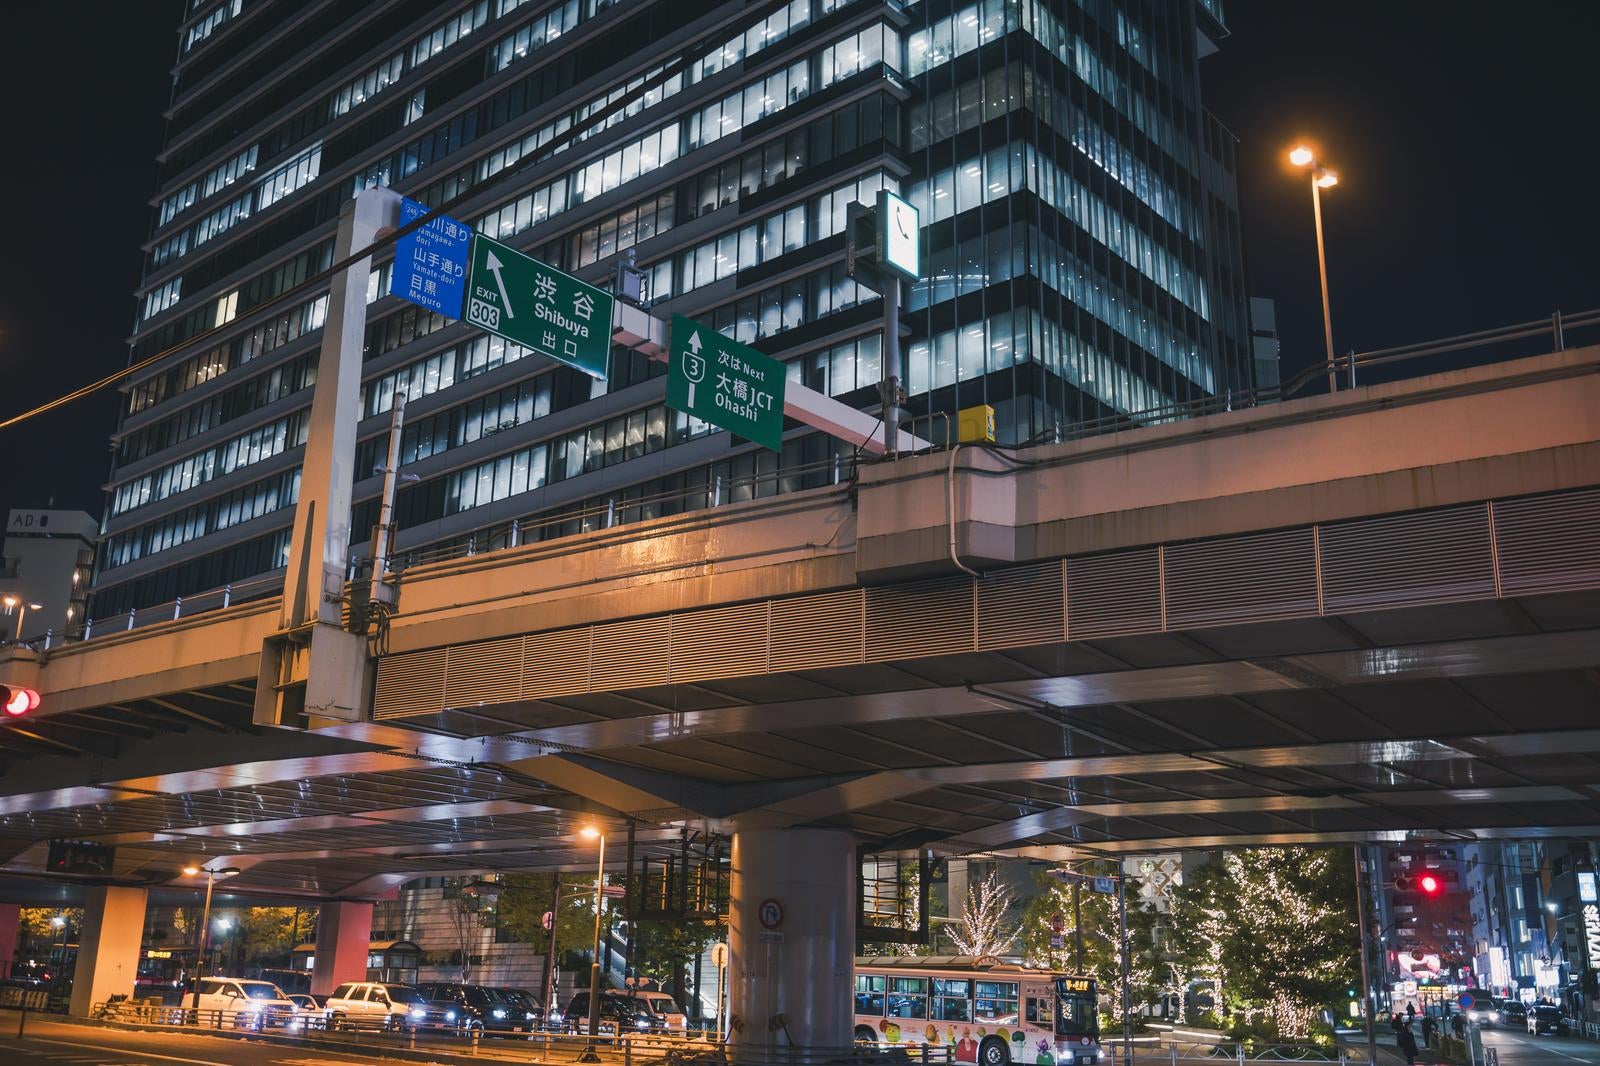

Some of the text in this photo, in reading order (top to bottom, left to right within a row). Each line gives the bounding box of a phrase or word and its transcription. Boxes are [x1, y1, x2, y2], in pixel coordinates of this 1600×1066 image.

[416, 235, 431, 247] dori
[413, 261, 455, 285] Yamate-dori
[414, 247, 463, 277] 山手通り
[411, 273, 437, 296] 目黒
[476, 286, 498, 302] EXIT
[533, 272, 594, 321] 渋谷
[409, 289, 441, 309] Meguro
[471, 301, 498, 329] 303
[535, 303, 589, 338] Shibuya
[542, 330, 577, 358] 出口
[690, 359, 698, 376] 3
[718, 349, 764, 382] 次は Next
[715, 392, 758, 422] Ohashi
